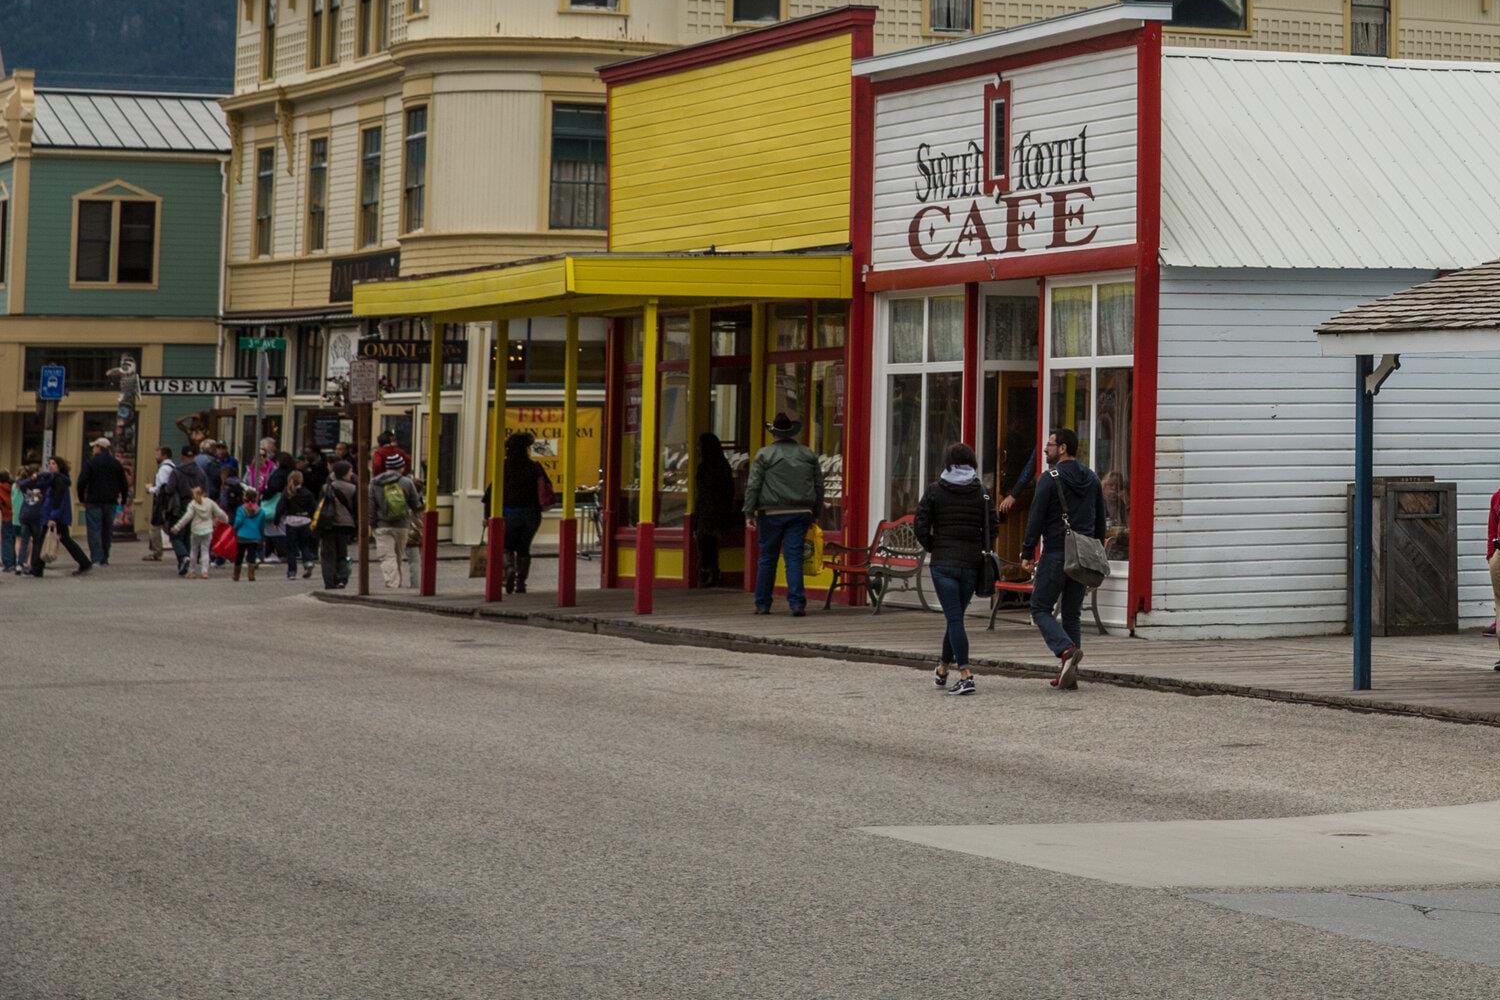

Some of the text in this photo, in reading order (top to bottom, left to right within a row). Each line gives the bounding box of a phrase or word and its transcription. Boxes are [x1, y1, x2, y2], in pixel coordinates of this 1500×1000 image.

[915, 138, 984, 203] SWEET
[908, 186, 1100, 262] CAFE
[363, 342, 417, 357] OMNI
[139, 380, 226, 393] MUSEUM
[542, 427, 593, 438] CHRM
